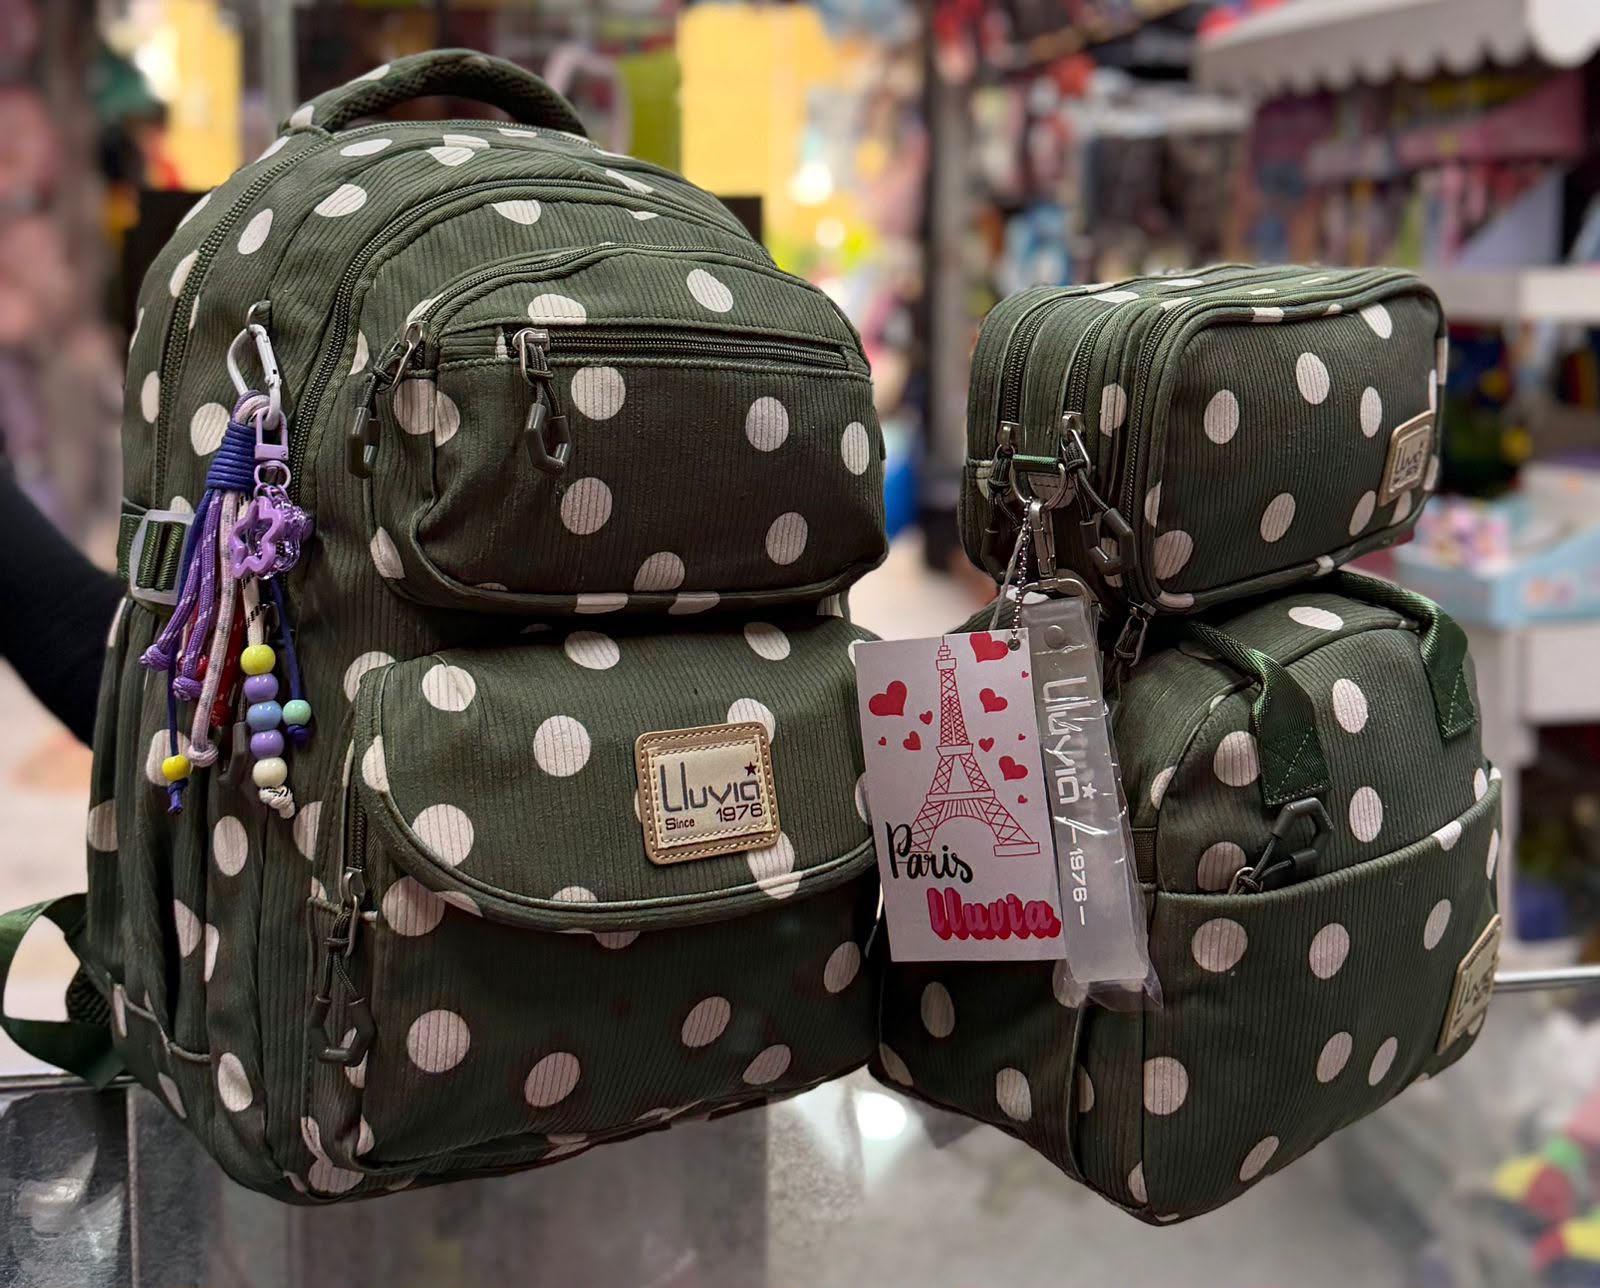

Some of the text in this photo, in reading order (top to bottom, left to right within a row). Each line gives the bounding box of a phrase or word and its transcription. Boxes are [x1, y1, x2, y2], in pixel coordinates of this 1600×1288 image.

[1043, 676, 1093, 804] Lluvia
[660, 761, 761, 812] Lluvia
[665, 802, 763, 831] Since 1976
[885, 822, 973, 883] Paris
